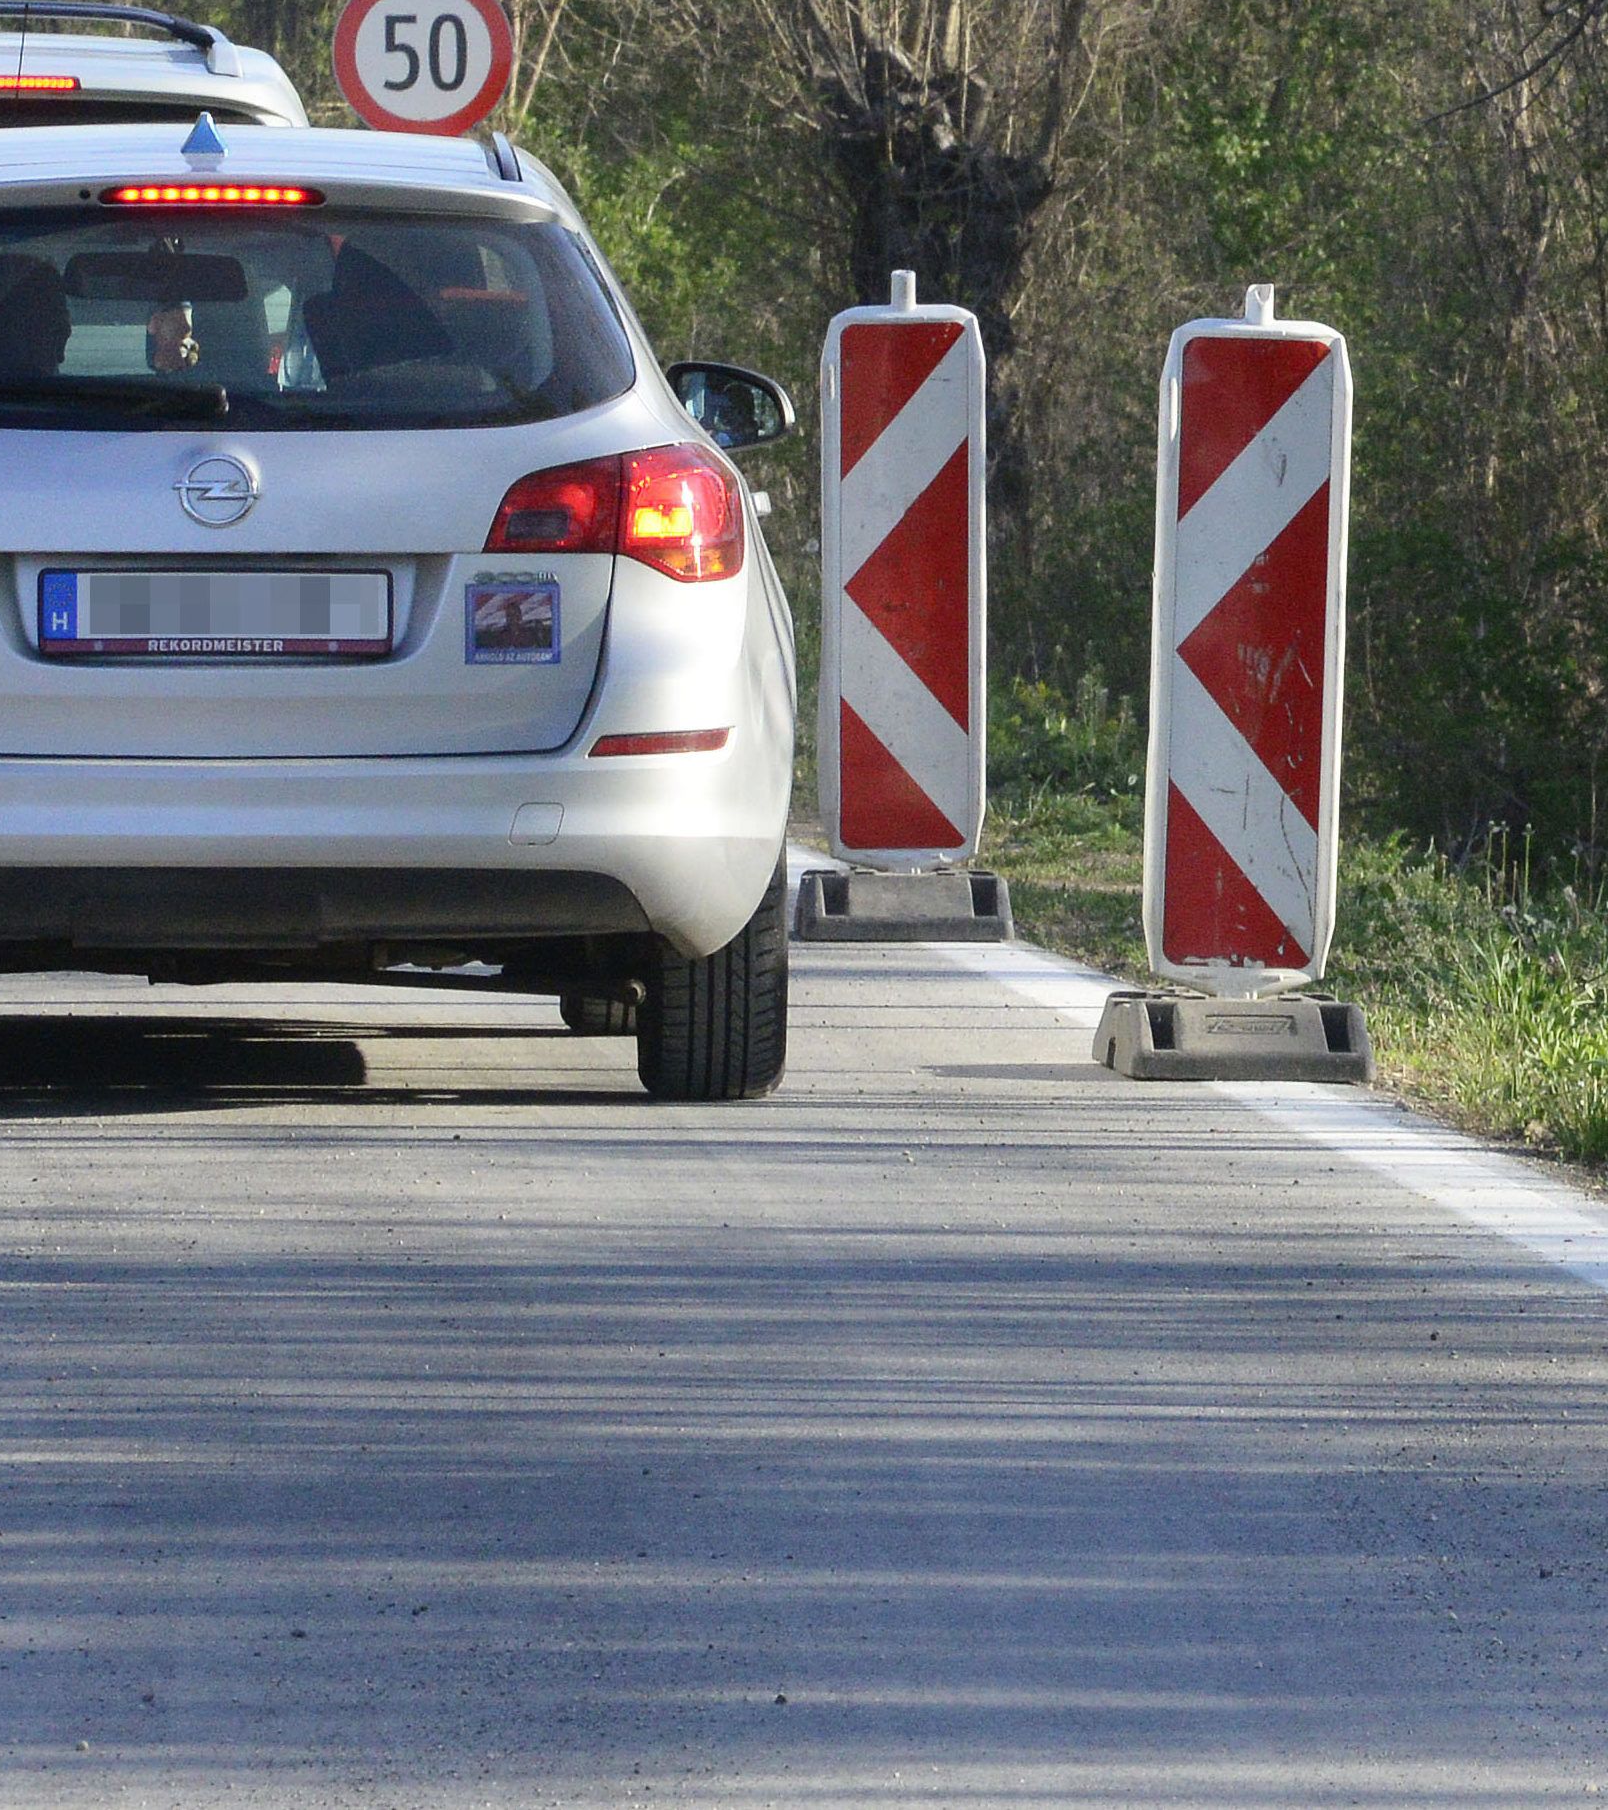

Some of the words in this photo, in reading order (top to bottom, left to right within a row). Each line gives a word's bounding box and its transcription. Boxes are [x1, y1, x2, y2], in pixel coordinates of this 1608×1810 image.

[383, 13, 468, 92] 50
[52, 611, 68, 631] H
[148, 640, 283, 652] REKORDMEISTER
